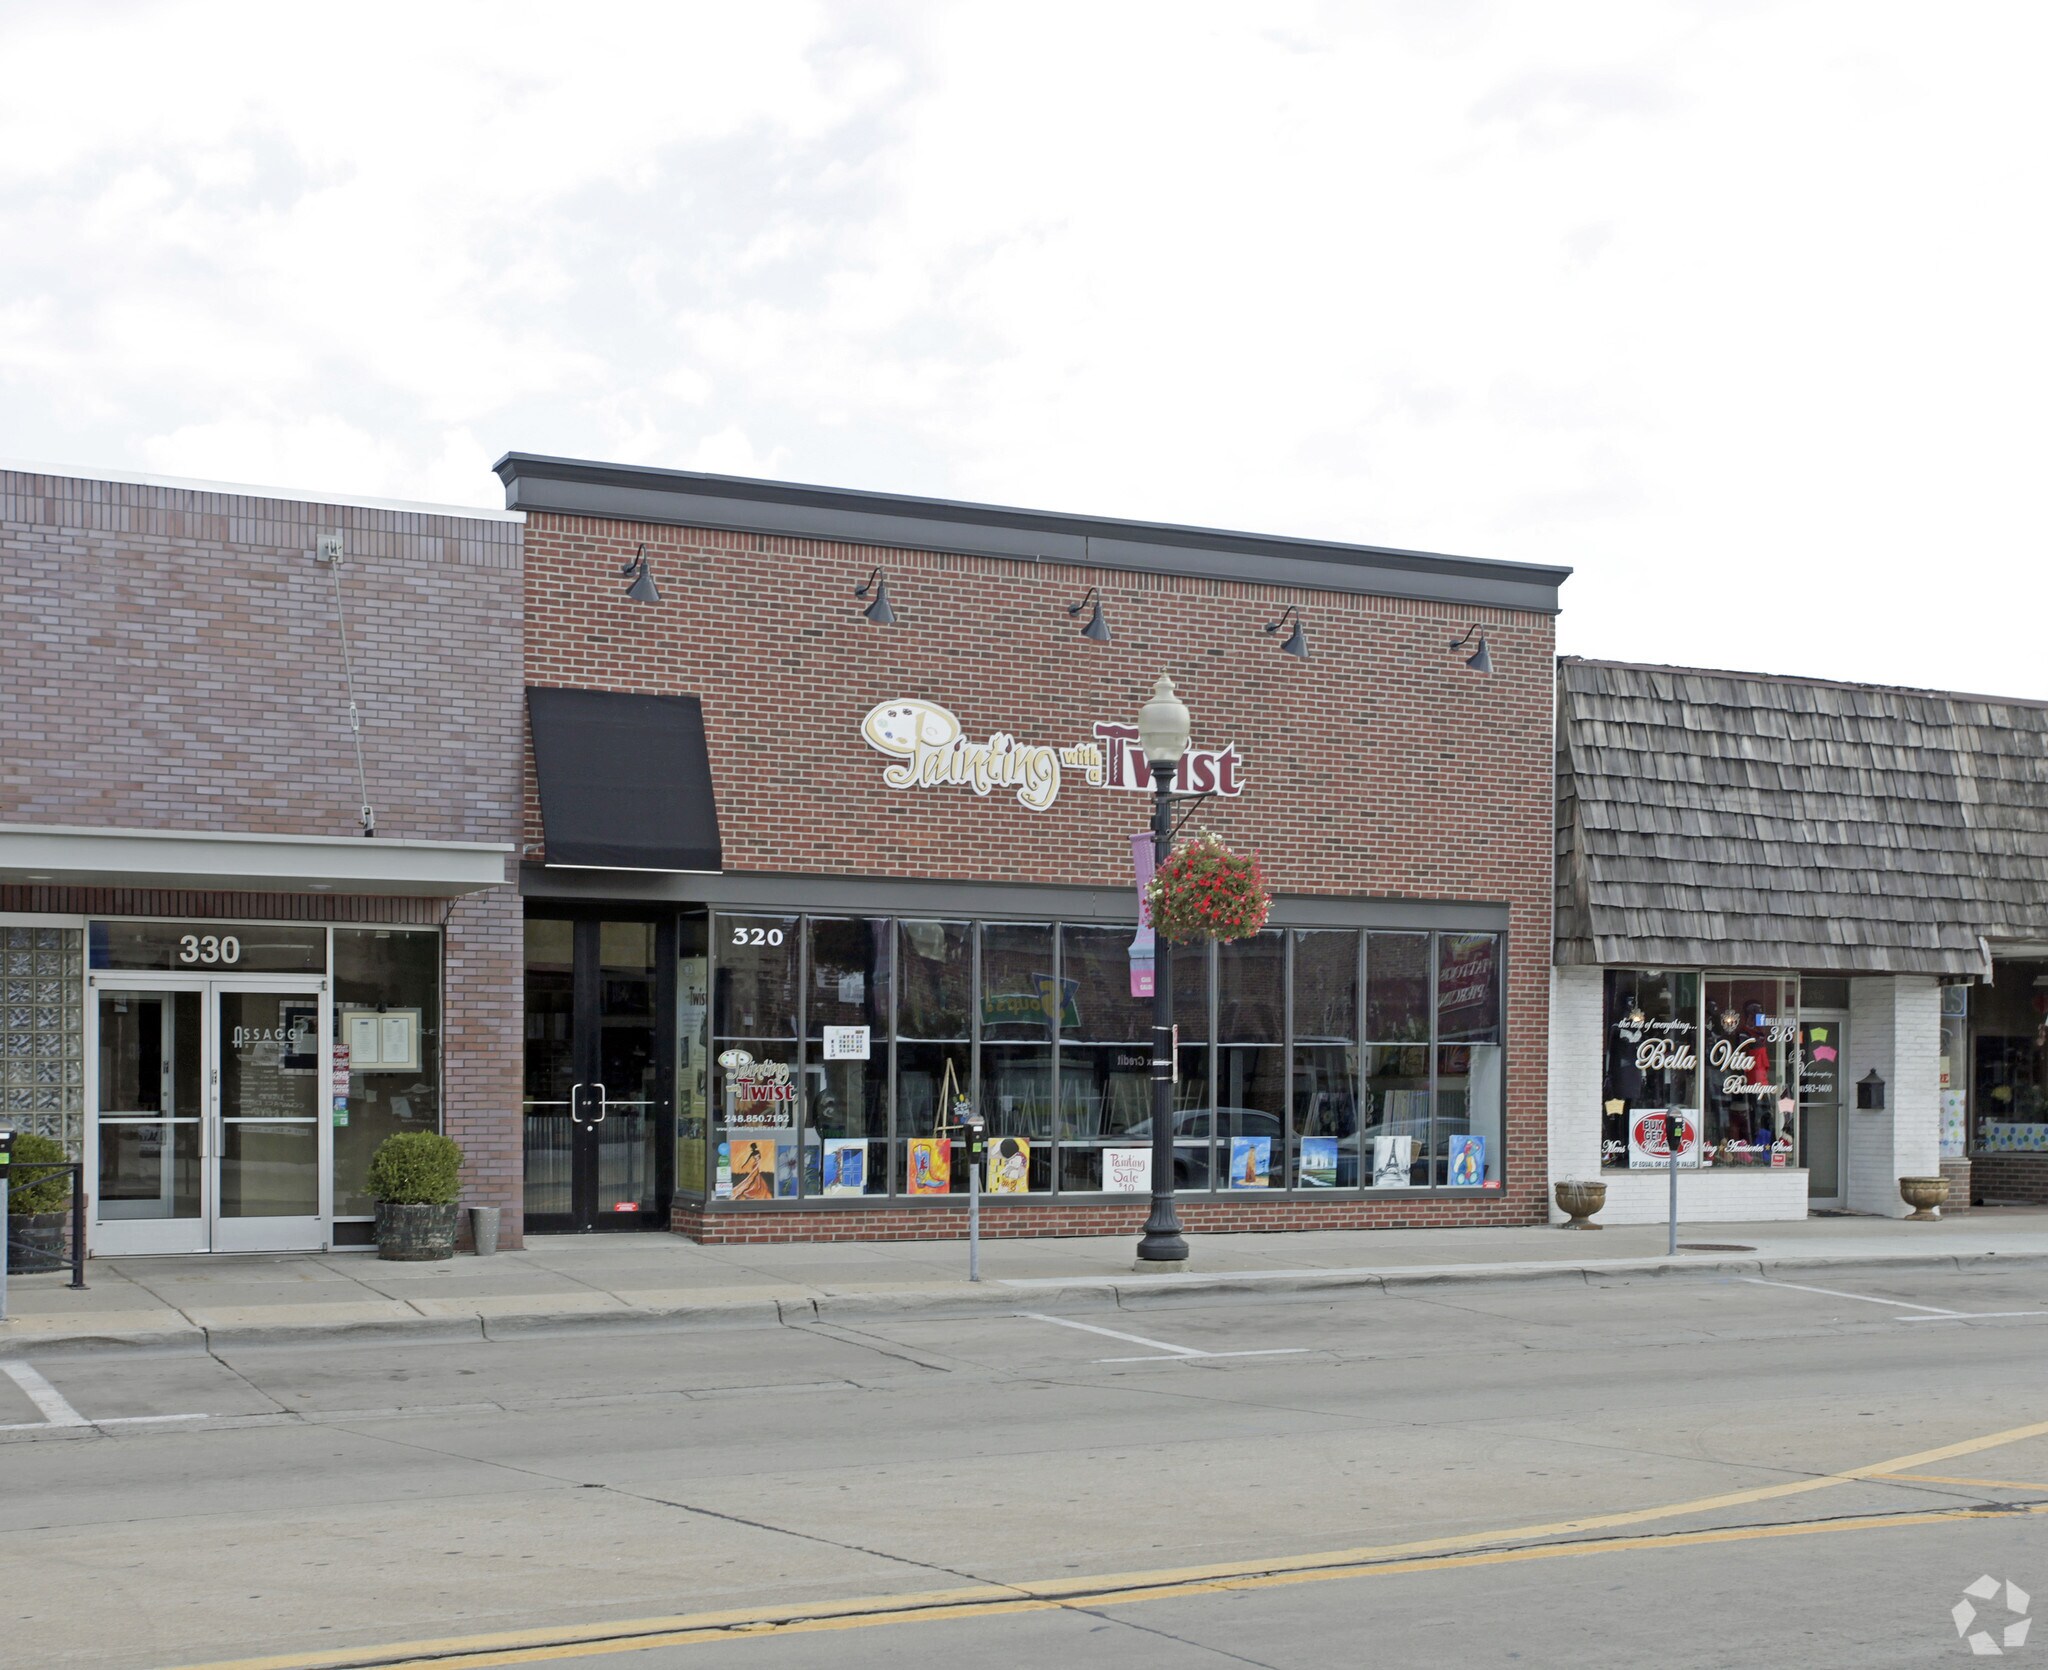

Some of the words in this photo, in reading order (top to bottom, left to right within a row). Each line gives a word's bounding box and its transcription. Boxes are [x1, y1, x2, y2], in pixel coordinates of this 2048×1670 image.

[864, 701, 1059, 808] Painting
[1063, 745, 1099, 765] with
[1089, 770, 1099, 782] a
[732, 927, 784, 946] 320
[180, 934, 240, 964] 330
[689, 986, 707, 1006] Twis
[1616, 1017, 1630, 1029] the
[1644, 1017, 1655, 1033] of
[1767, 1026, 1796, 1042] 318
[231, 1026, 304, 1048] ASSAGGI
[1635, 1037, 1697, 1070] Bella
[1709, 1037, 1757, 1073] Vita
[718, 1049, 790, 1085] Painting
[736, 1078, 795, 1101] Twist
[1722, 1075, 1778, 1101] Boutique
[724, 1114, 789, 1123] 248.850.7182
[1643, 1119, 1665, 1131] BUY
[1644, 1131, 1664, 1141] GET
[1601, 1139, 1626, 1153] Mens
[1771, 1140, 1793, 1152] Shoes
[1110, 1153, 1145, 1172] Painting
[1113, 1169, 1139, 1183] Sale
